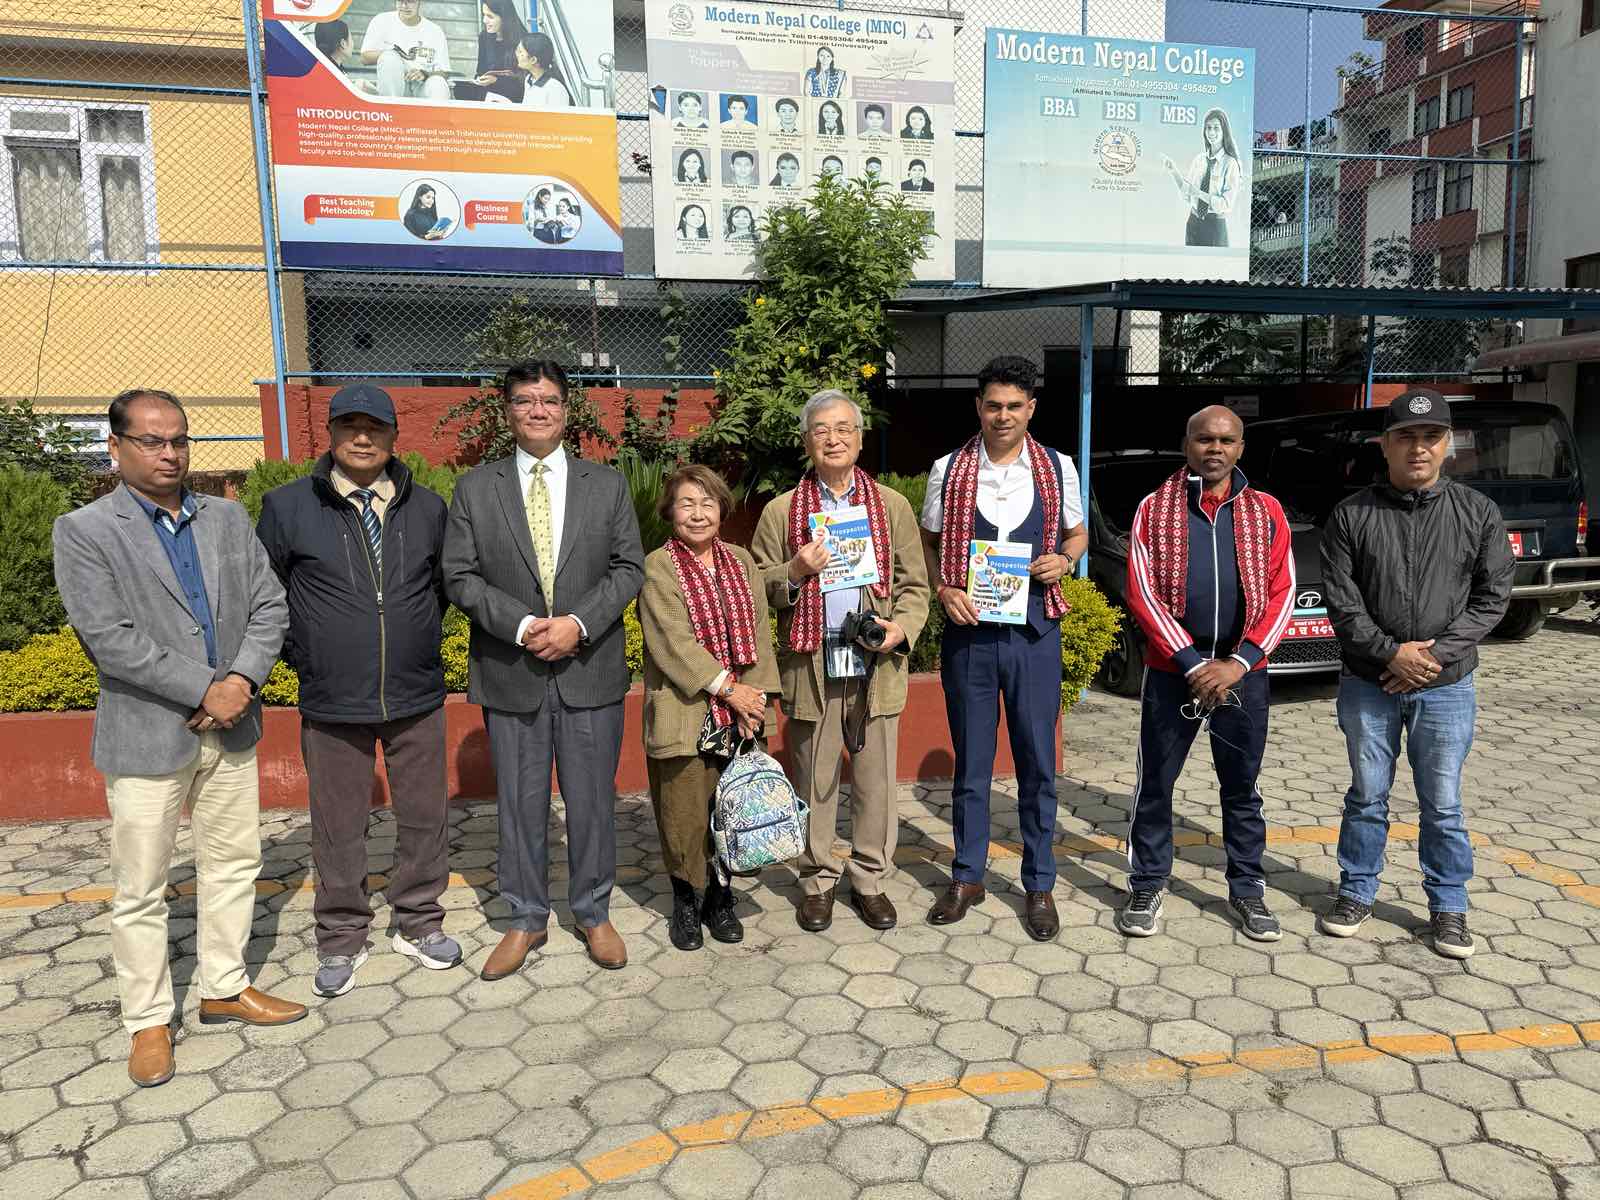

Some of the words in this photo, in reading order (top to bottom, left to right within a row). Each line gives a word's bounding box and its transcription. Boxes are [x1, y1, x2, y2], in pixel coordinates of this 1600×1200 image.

[705, 6, 760, 25] Modern
[765, 11, 805, 30] Nepal
[810, 14, 861, 35] College
[866, 18, 906, 39] (MNC)
[735, 35, 776, 43] (Affiliated
[831, 42, 875, 50] University)
[996, 33, 1086, 67] Modern
[1093, 42, 1158, 77] Nepal
[1165, 47, 1245, 84] College
[1112, 78, 1128, 87] Tel:
[1072, 88, 1104, 96] (Affiliated
[1113, 90, 1144, 98] Tribhuvan
[1146, 93, 1179, 101] University)
[296, 107, 393, 122] INTRODUCTION:
[1044, 97, 1076, 117] BBA
[1106, 101, 1137, 121] BBS
[1162, 105, 1196, 124] MBS
[298, 122, 327, 130] Modern
[329, 123, 350, 131] Nepal
[352, 124, 379, 132] College
[406, 127, 437, 135] affiliated
[438, 128, 455, 136] with
[456, 129, 491, 138] Tribhuvan
[299, 139, 332, 147] essential
[360, 142, 394, 151] country's
[395, 144, 442, 153] development
[443, 145, 472, 154] through
[347, 132, 397, 141] professionally
[398, 135, 427, 143] relevant
[474, 138, 502, 147] develop
[299, 147, 325, 157] faculty
[327, 148, 341, 156] and
[343, 149, 375, 158] top-level
[319, 197, 338, 205] Best
[338, 198, 375, 208] Teaching
[475, 203, 509, 212] Business
[320, 206, 375, 217] Methodology
[476, 213, 508, 222] Courses
[990, 561, 1028, 569] Prospectus
